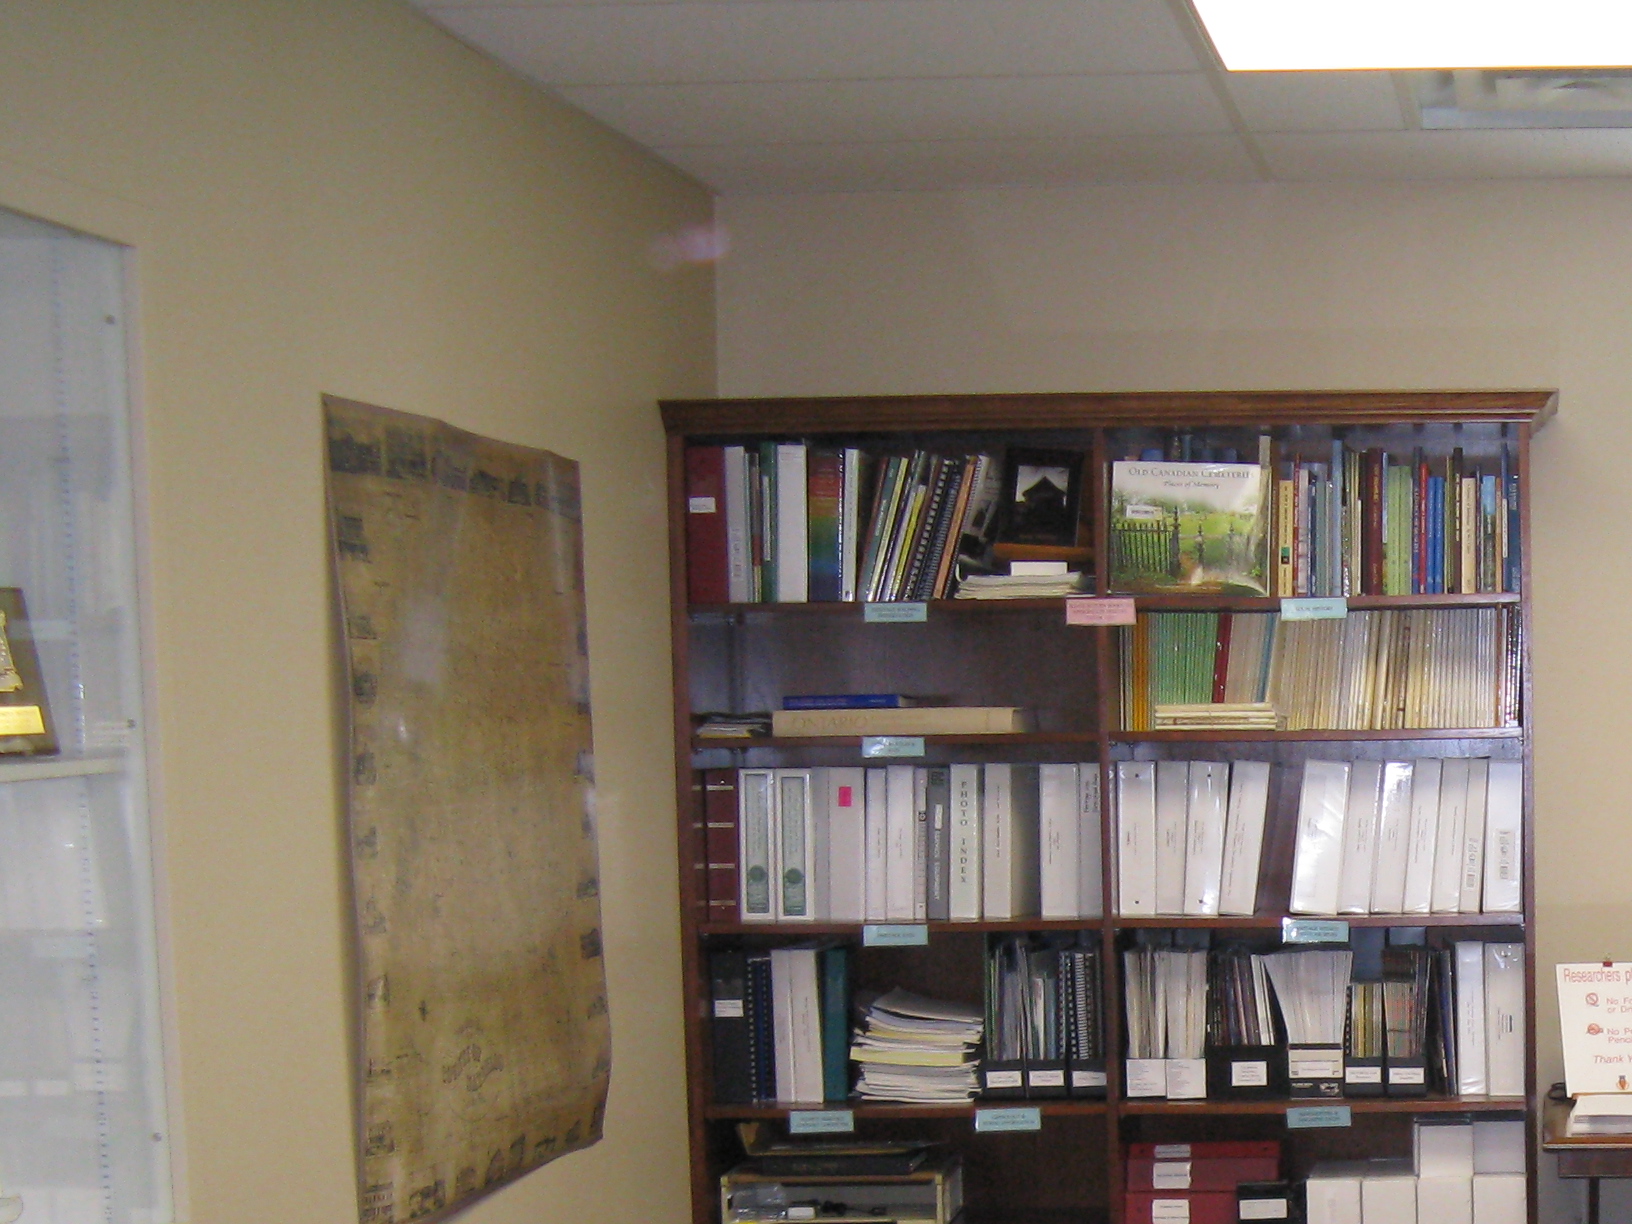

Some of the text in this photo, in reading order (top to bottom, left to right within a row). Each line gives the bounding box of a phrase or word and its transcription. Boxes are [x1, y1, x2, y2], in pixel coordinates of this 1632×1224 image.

[1128, 467, 1150, 476] OLD
[1151, 467, 1199, 477] CANADIAN
[960, 781, 968, 883] PHOTO INDEX
[1563, 968, 1621, 983] Researchers
[1606, 997, 1618, 1005] No
[1594, 1055, 1623, 1064] Thank
